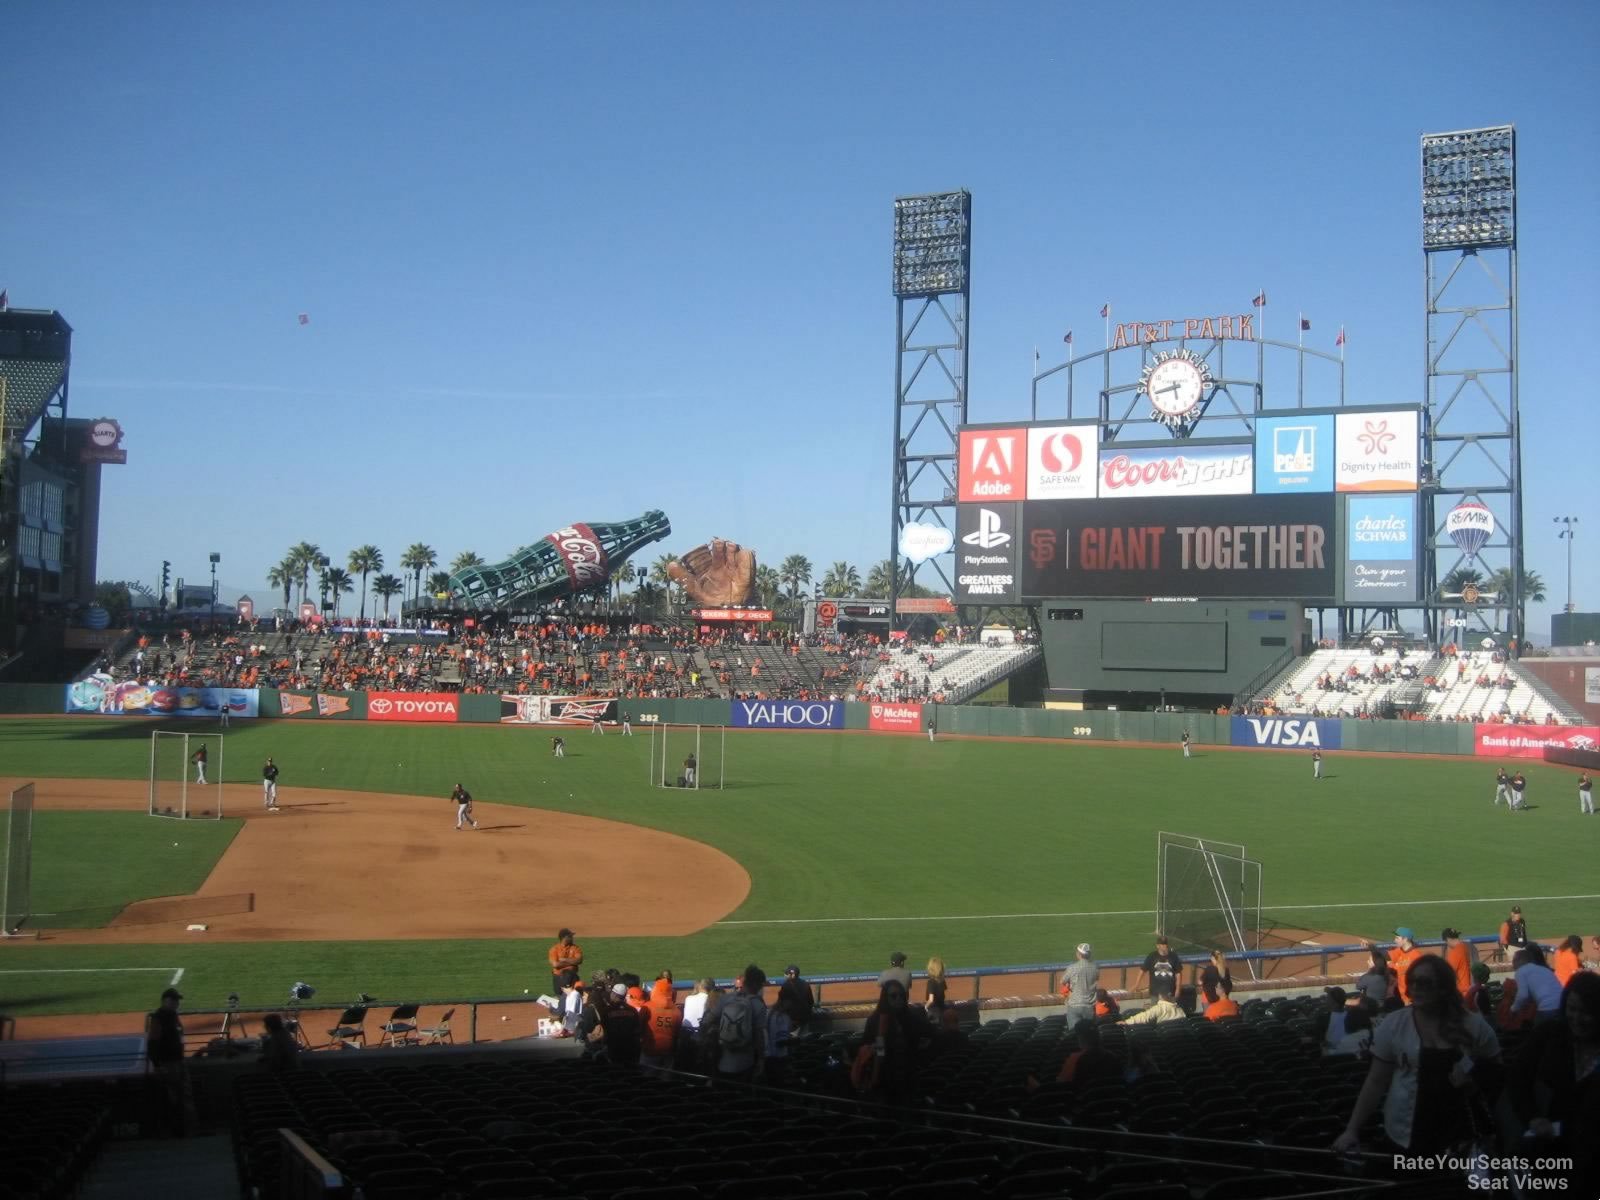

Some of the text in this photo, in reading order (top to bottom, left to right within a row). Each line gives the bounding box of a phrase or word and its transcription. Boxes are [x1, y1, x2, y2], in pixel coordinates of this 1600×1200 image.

[1113, 314, 1254, 349] AT&T PARK
[1137, 348, 1214, 394] SAN FRANCISCO
[1149, 405, 1201, 426] GIANTS
[1103, 455, 1185, 489] Coors
[1341, 461, 1411, 473] Dignity Health
[1040, 475, 1081, 485] SAFEWAY
[973, 481, 1012, 496] Adobe
[1355, 514, 1406, 530] charles
[1451, 512, 1489, 525] RE/MAX
[1355, 531, 1407, 542] SCHWAB
[1080, 526, 1165, 570] GIANT
[1177, 525, 1325, 570] TOGETHER
[959, 575, 1013, 585] GREATNESS
[1379, 569, 1406, 580] your
[395, 700, 456, 713] TOYOTA
[884, 708, 918, 718] McAfee
[742, 702, 834, 726] YAHOO!
[1073, 726, 1092, 736] 399
[1247, 719, 1320, 746] VISA
[1483, 736, 1565, 748] Bank of America
